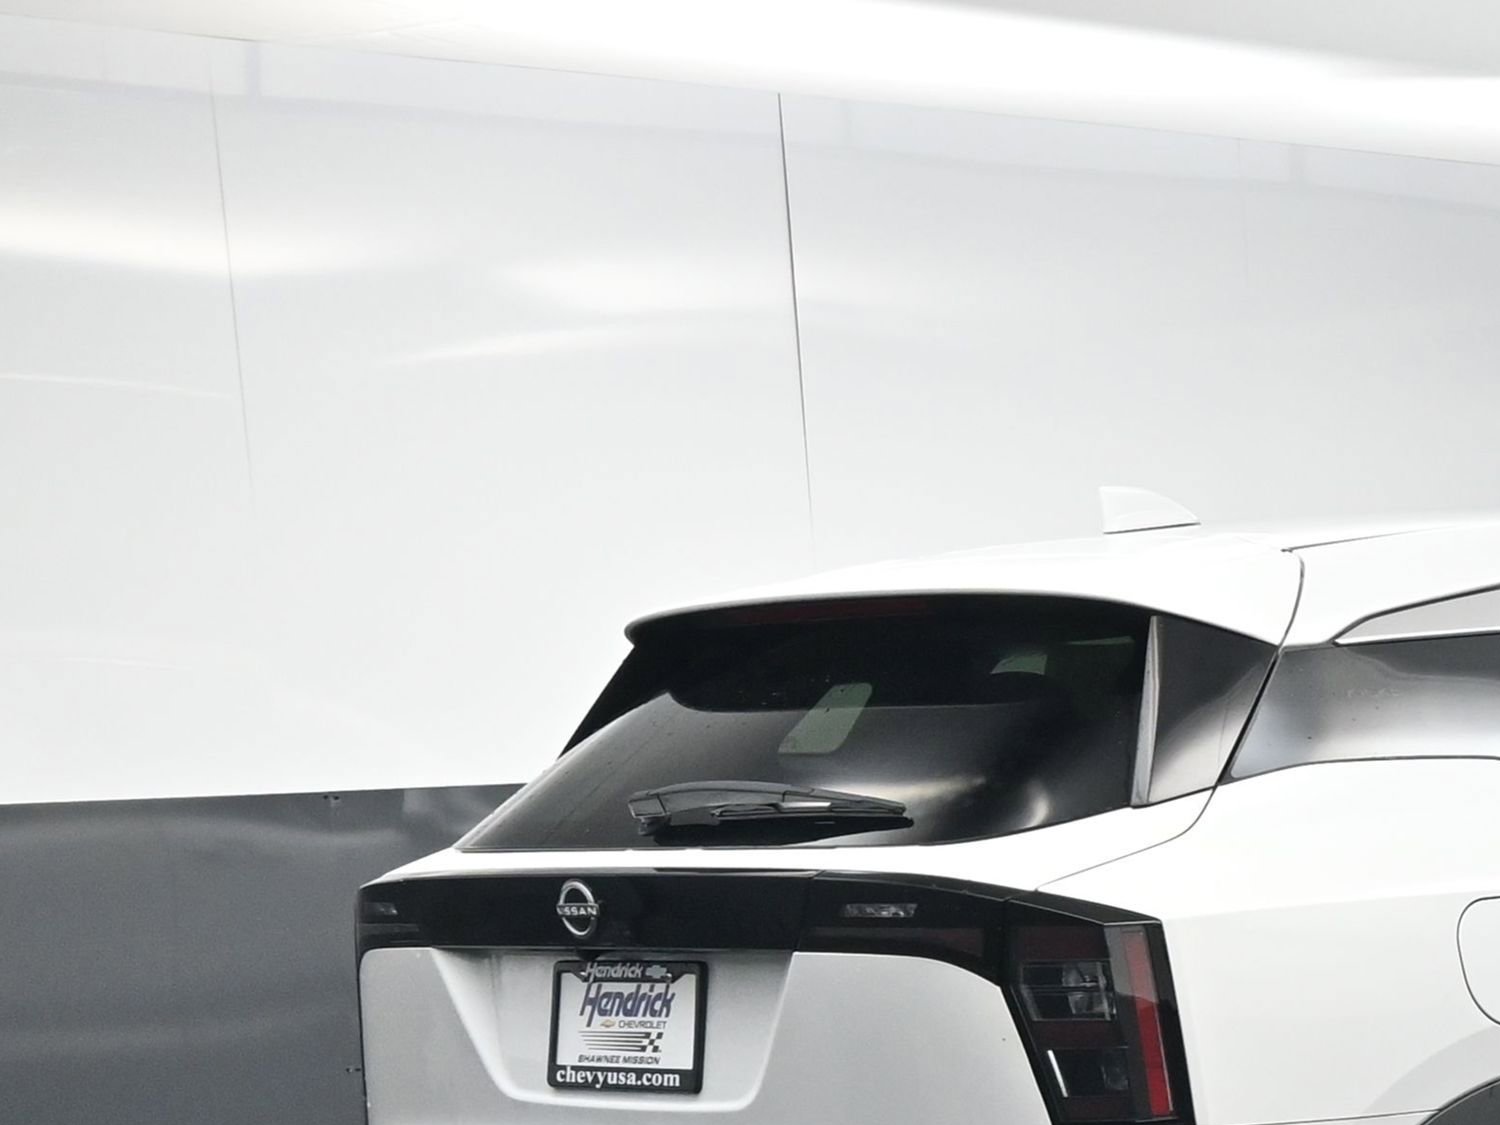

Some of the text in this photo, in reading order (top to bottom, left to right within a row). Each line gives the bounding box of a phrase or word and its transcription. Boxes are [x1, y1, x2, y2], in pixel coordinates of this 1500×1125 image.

[557, 905, 598, 917] NISSAN
[585, 962, 644, 982] Hendrick
[579, 983, 676, 1028] Hendrick
[618, 1020, 667, 1030] CHEVROLET
[577, 1054, 661, 1065] SHAWNEE MISSION
[556, 1065, 680, 1088] chevyusa.com
